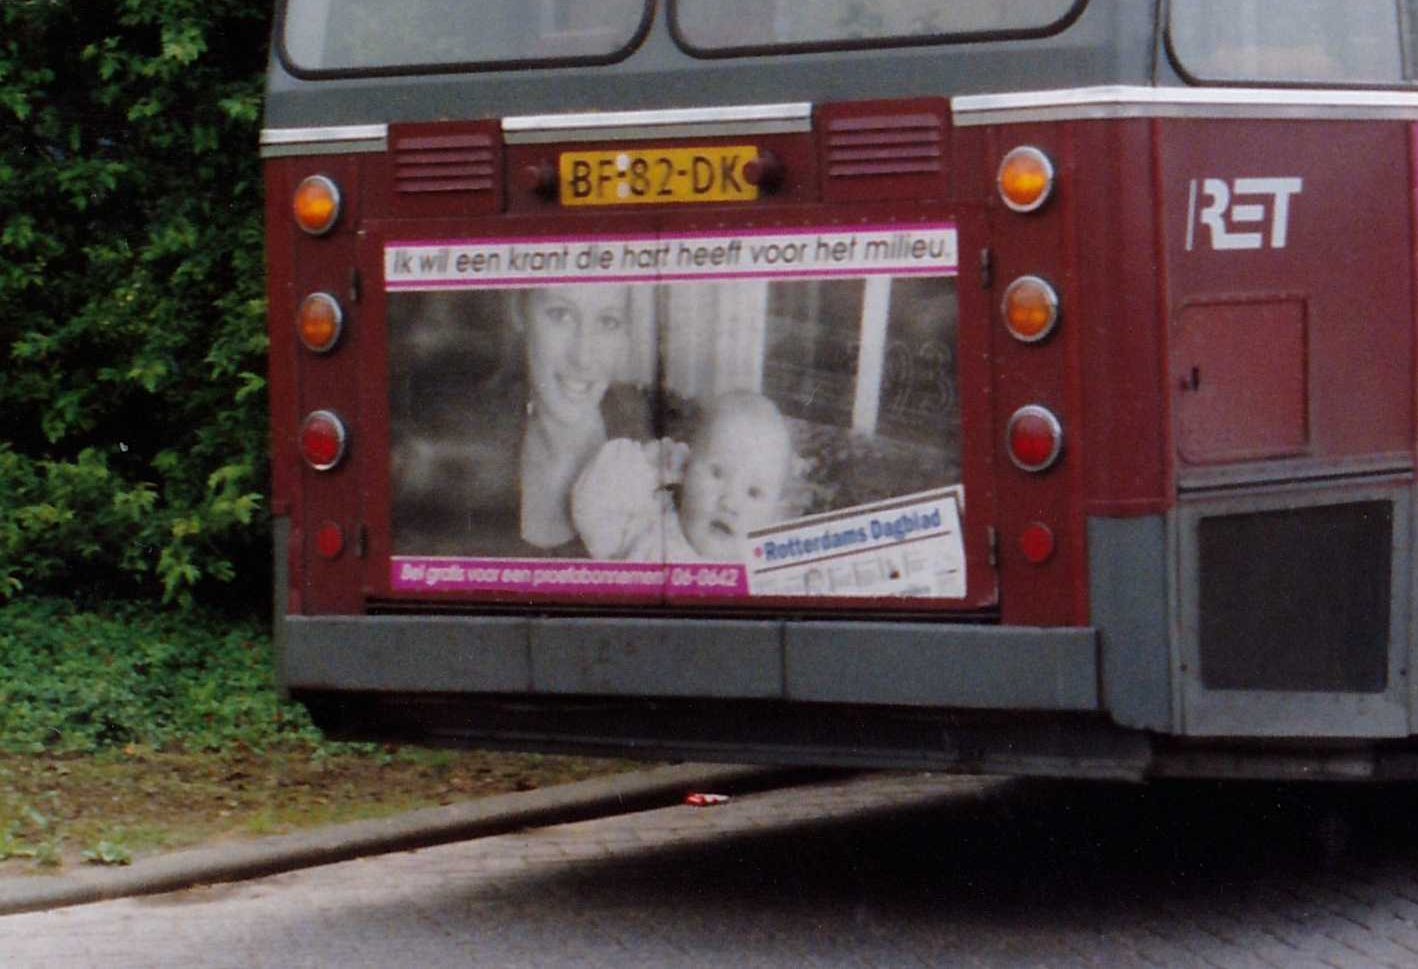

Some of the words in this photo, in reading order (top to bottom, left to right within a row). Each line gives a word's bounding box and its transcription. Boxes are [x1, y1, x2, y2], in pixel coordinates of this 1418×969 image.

[570, 155, 742, 199] BF-82-DK
[1200, 177, 1303, 251] RET
[418, 249, 448, 273] wil
[455, 251, 500, 272] een
[508, 246, 568, 272] krant
[576, 243, 614, 270] die
[621, 242, 670, 270] hart
[677, 238, 742, 267] heeft
[750, 240, 808, 265] voor
[815, 232, 858, 263] het
[864, 231, 949, 261] milieu.
[763, 526, 868, 562] Rotterdams
[869, 507, 941, 542] Dagblad
